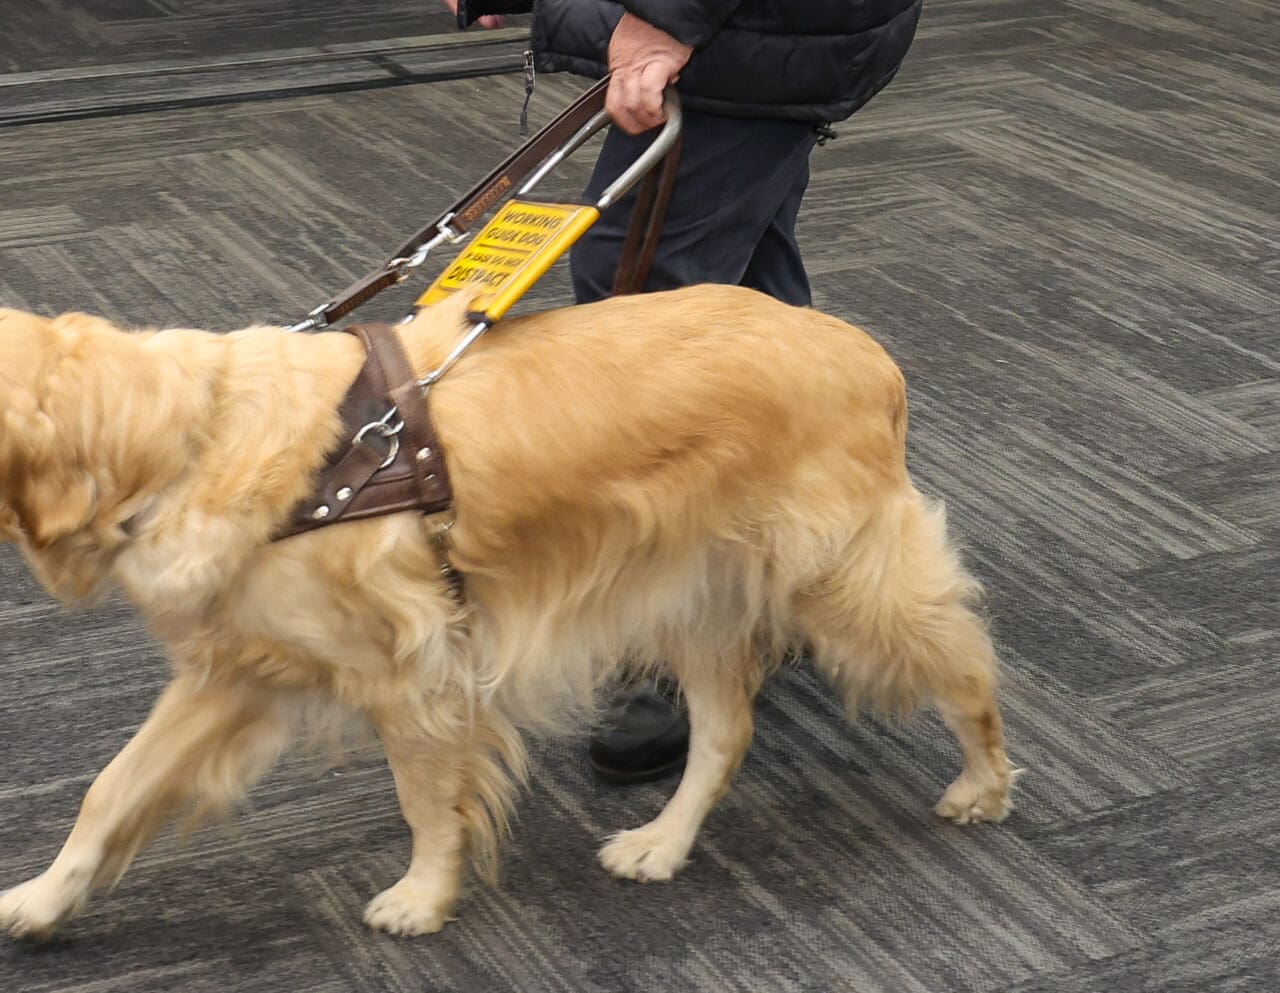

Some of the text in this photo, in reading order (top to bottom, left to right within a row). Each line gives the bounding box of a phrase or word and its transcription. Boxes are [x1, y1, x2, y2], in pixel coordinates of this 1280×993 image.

[500, 210, 563, 229] WORKING
[485, 227, 547, 246] GUIDE DOG
[446, 265, 511, 287] DISTRACT
